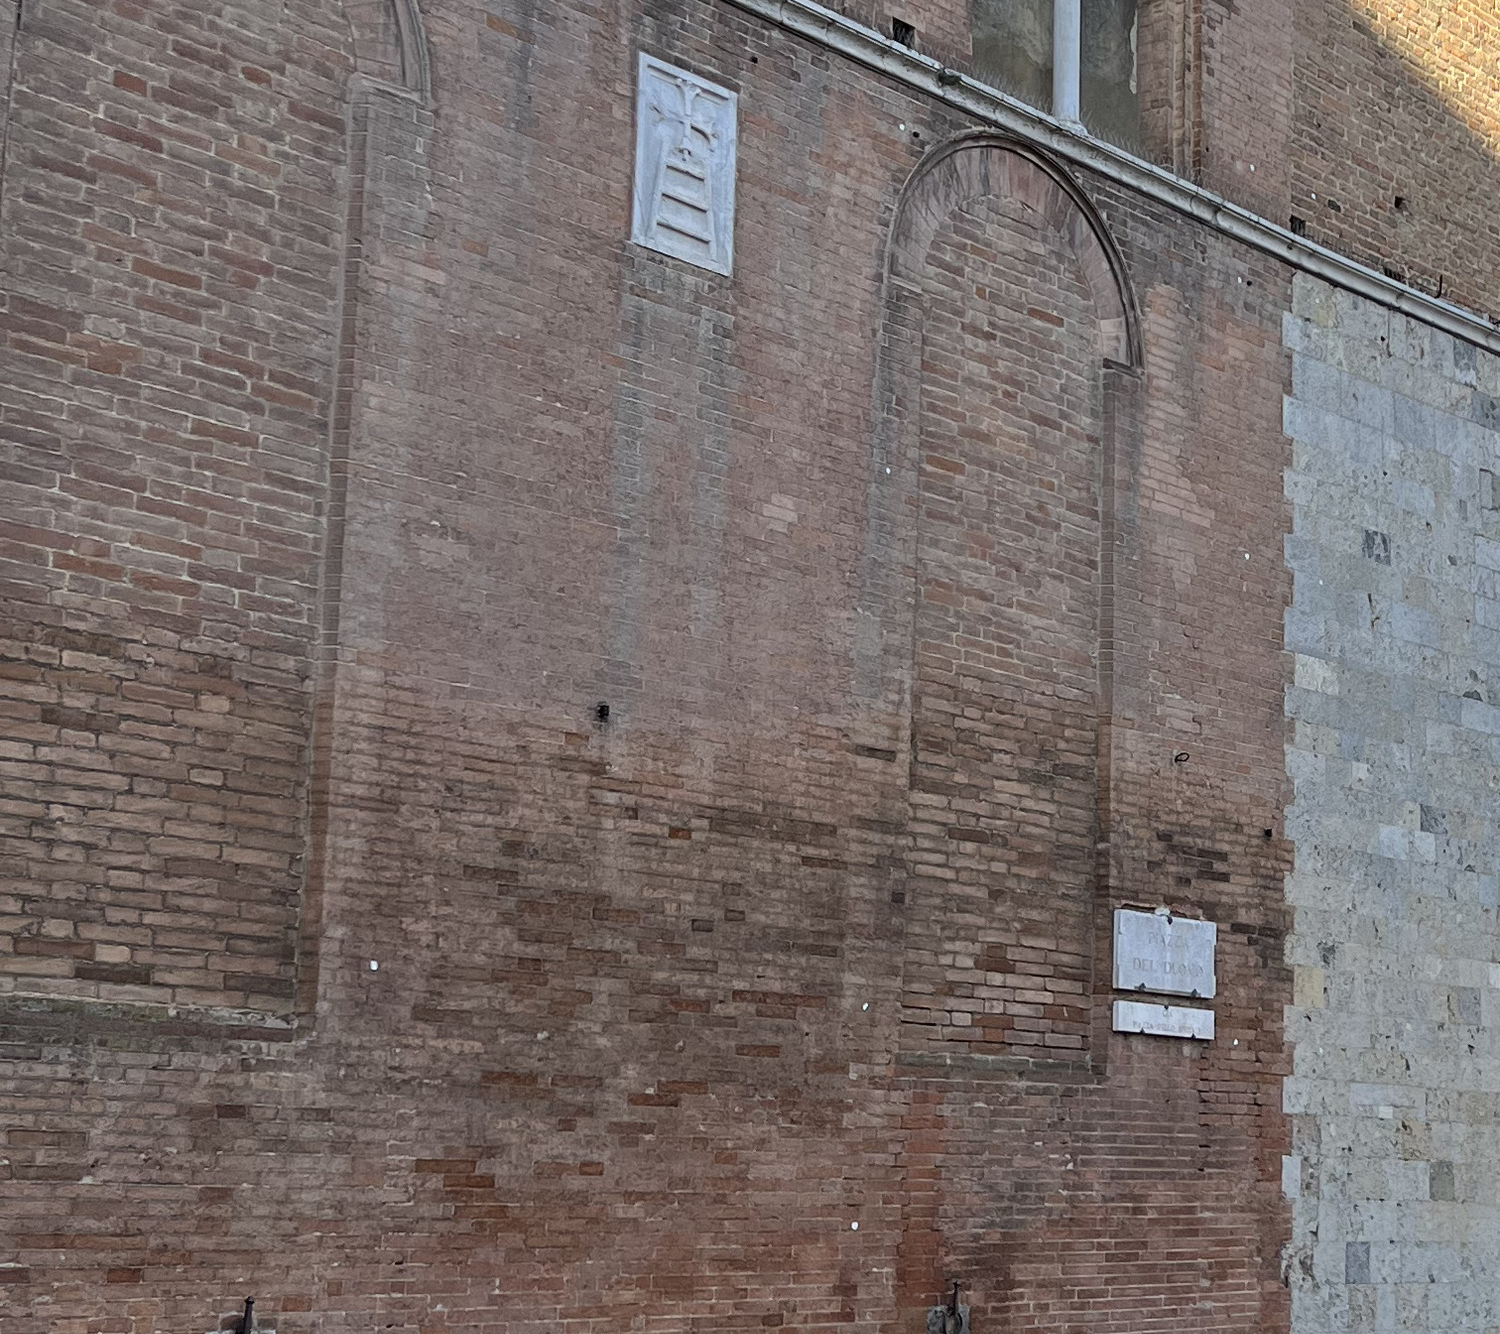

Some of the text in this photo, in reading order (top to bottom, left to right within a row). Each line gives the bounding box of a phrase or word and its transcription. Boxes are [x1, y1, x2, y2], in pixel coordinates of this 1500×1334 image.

[1148, 931, 1189, 948] PIAZZA
[1133, 955, 1204, 977] DEL DUOMO
